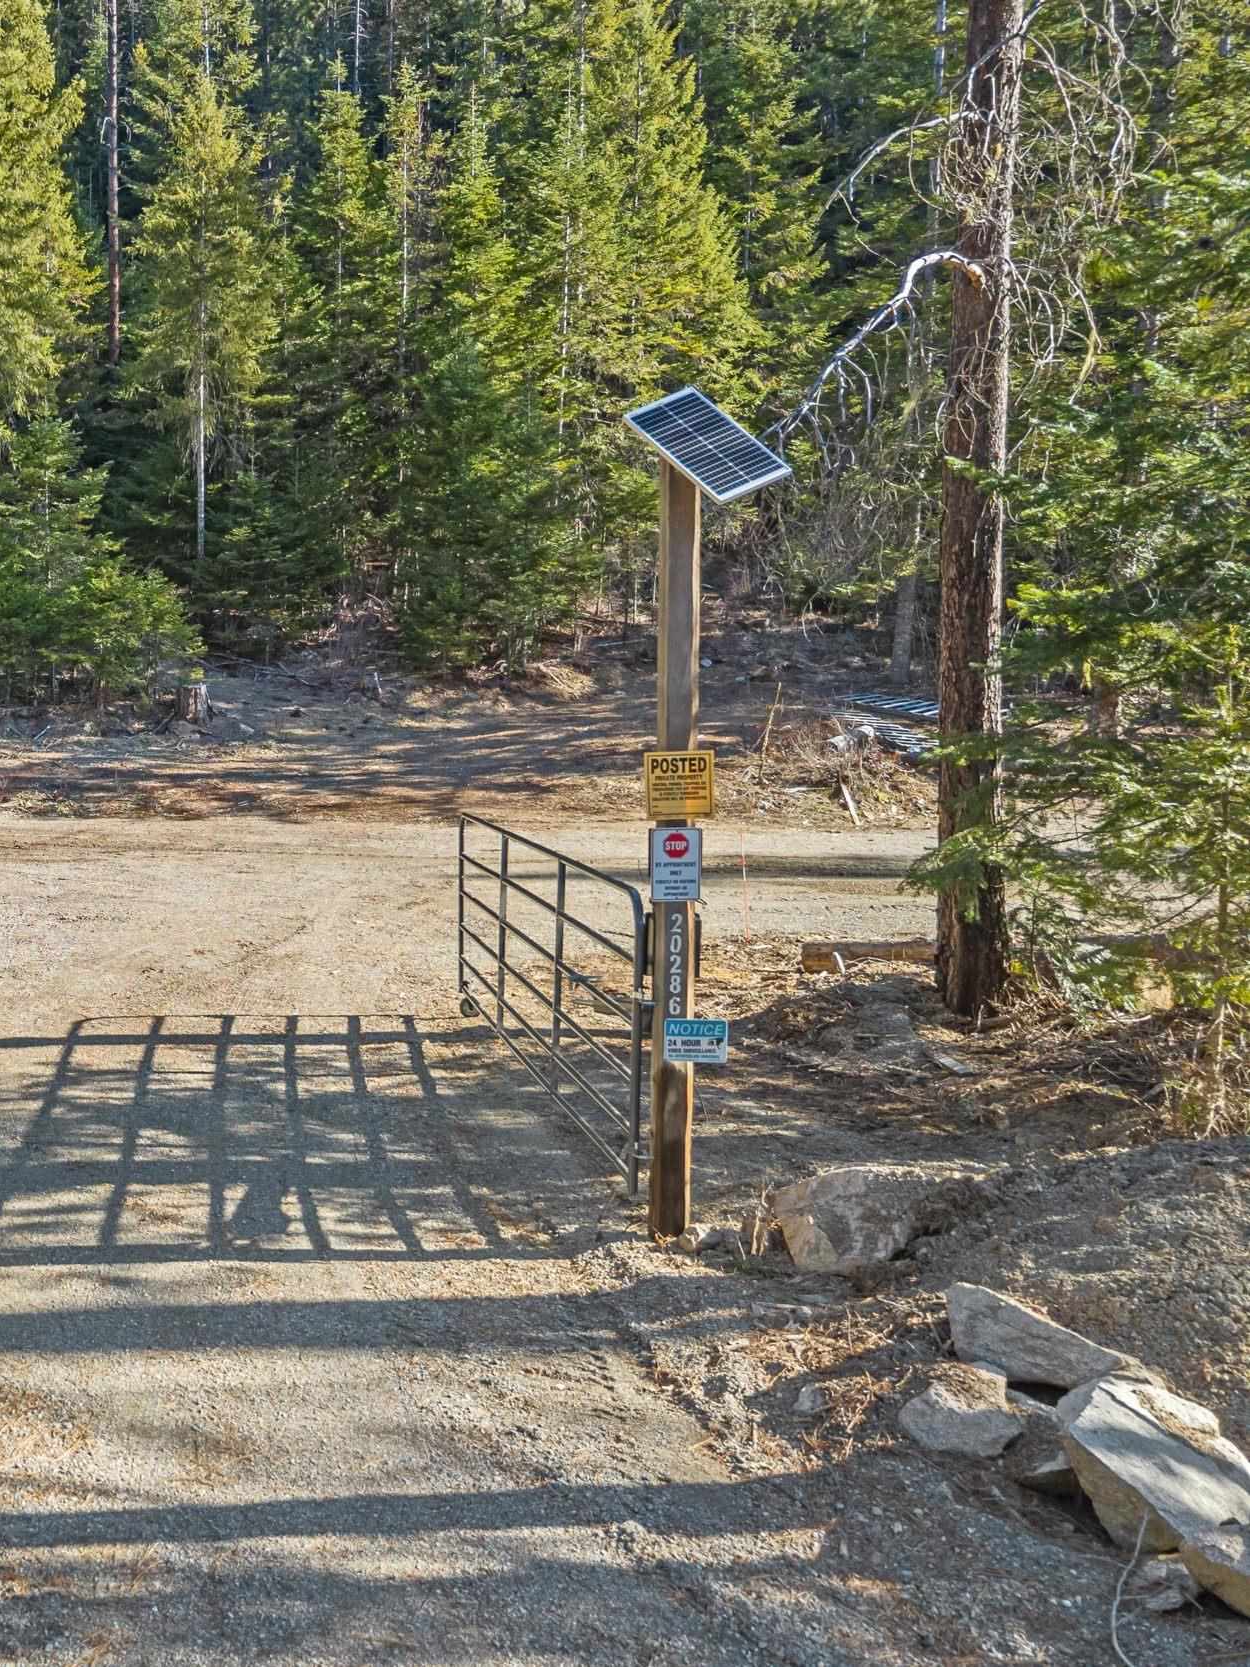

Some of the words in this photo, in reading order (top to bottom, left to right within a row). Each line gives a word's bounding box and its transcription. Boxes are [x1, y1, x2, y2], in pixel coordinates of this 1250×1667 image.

[651, 757, 707, 774] POSTED
[665, 841, 687, 851] STOP
[668, 913, 683, 1015] 20286
[668, 1023, 724, 1035] NOTICE
[667, 1039, 677, 1047] 24
[681, 1039, 701, 1047] HOUR
